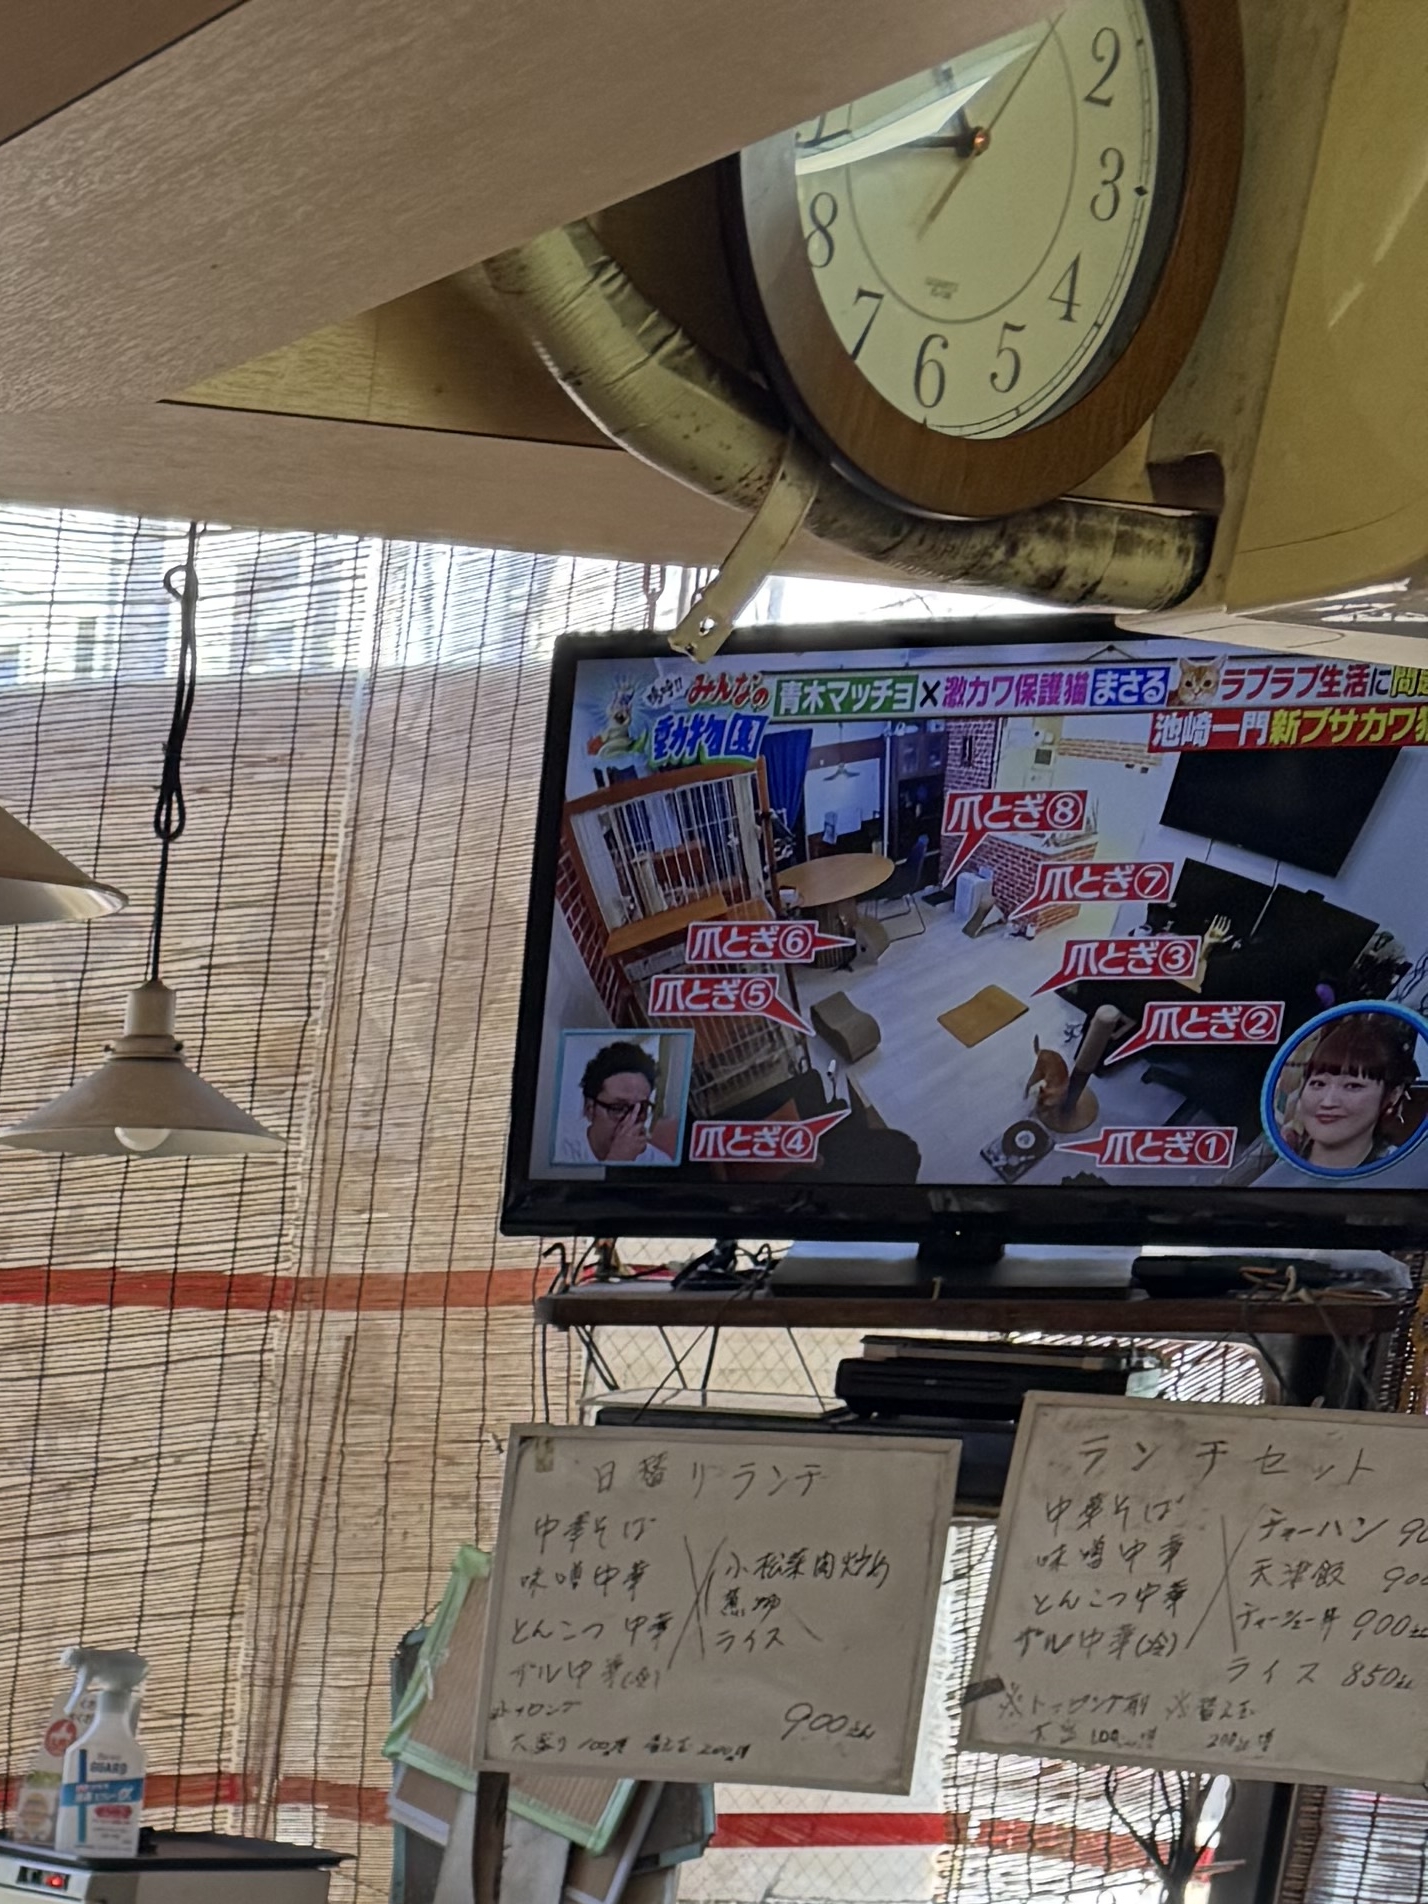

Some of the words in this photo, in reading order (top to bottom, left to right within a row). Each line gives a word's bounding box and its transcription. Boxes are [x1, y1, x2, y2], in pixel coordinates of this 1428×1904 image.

[1083, 27, 1120, 107] 2
[1089, 147, 1124, 222] 3
[804, 191, 839, 269] 8
[1047, 252, 1082, 323] 4
[851, 287, 885, 362] 7
[989, 322, 1026, 393] 5
[913, 333, 949, 408] 6
[652, 712, 770, 763] 動物園
[1077, 1435, 1375, 1486] ランチセット
[715, 1626, 786, 1656] ライス
[1226, 1656, 1320, 1685] ライス
